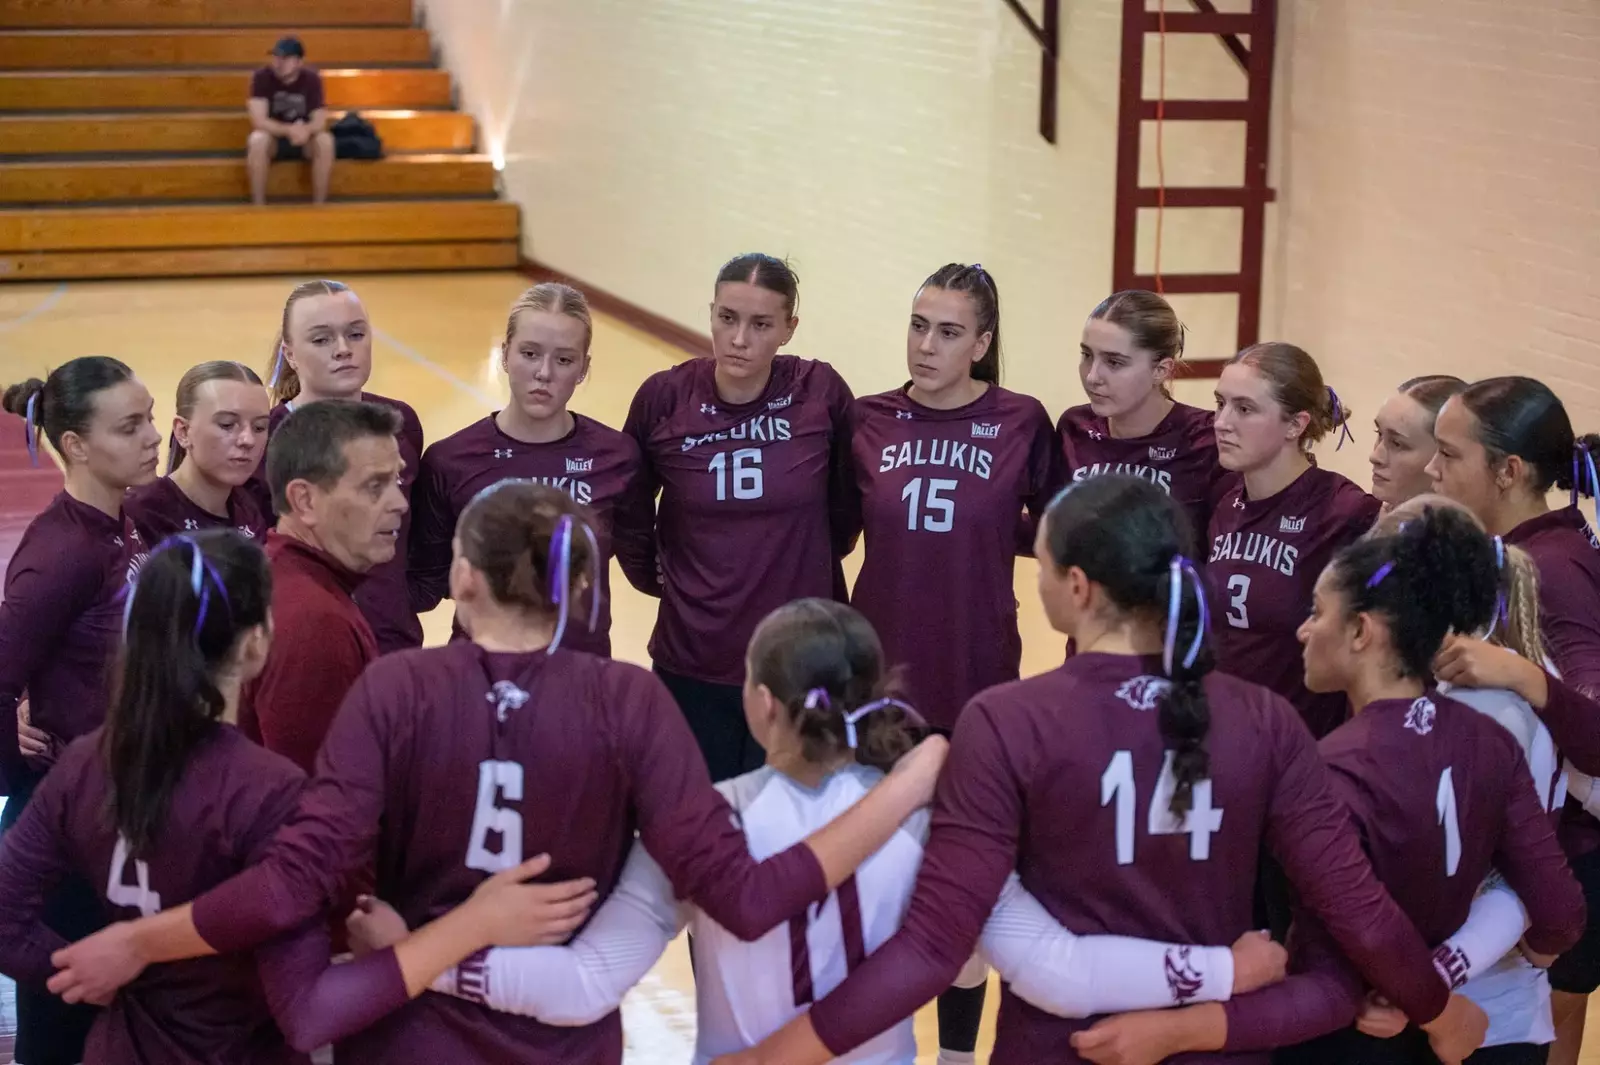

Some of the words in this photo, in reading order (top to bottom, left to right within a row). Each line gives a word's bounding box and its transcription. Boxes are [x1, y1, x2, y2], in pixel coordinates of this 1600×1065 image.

[971, 421, 1002, 436] VALLEY
[1148, 445, 1177, 460] VALLEY
[566, 457, 594, 471] VALLEY
[707, 448, 764, 501] 16
[879, 439, 993, 480] SALUKIS
[901, 477, 959, 533] 15
[1279, 515, 1307, 531] VALLEY
[1209, 532, 1299, 577] SALUKIS
[1225, 574, 1251, 629] 3
[465, 759, 525, 873] 6
[1100, 750, 1223, 865] 14
[1436, 766, 1463, 877] 1
[106, 832, 162, 917] 4
